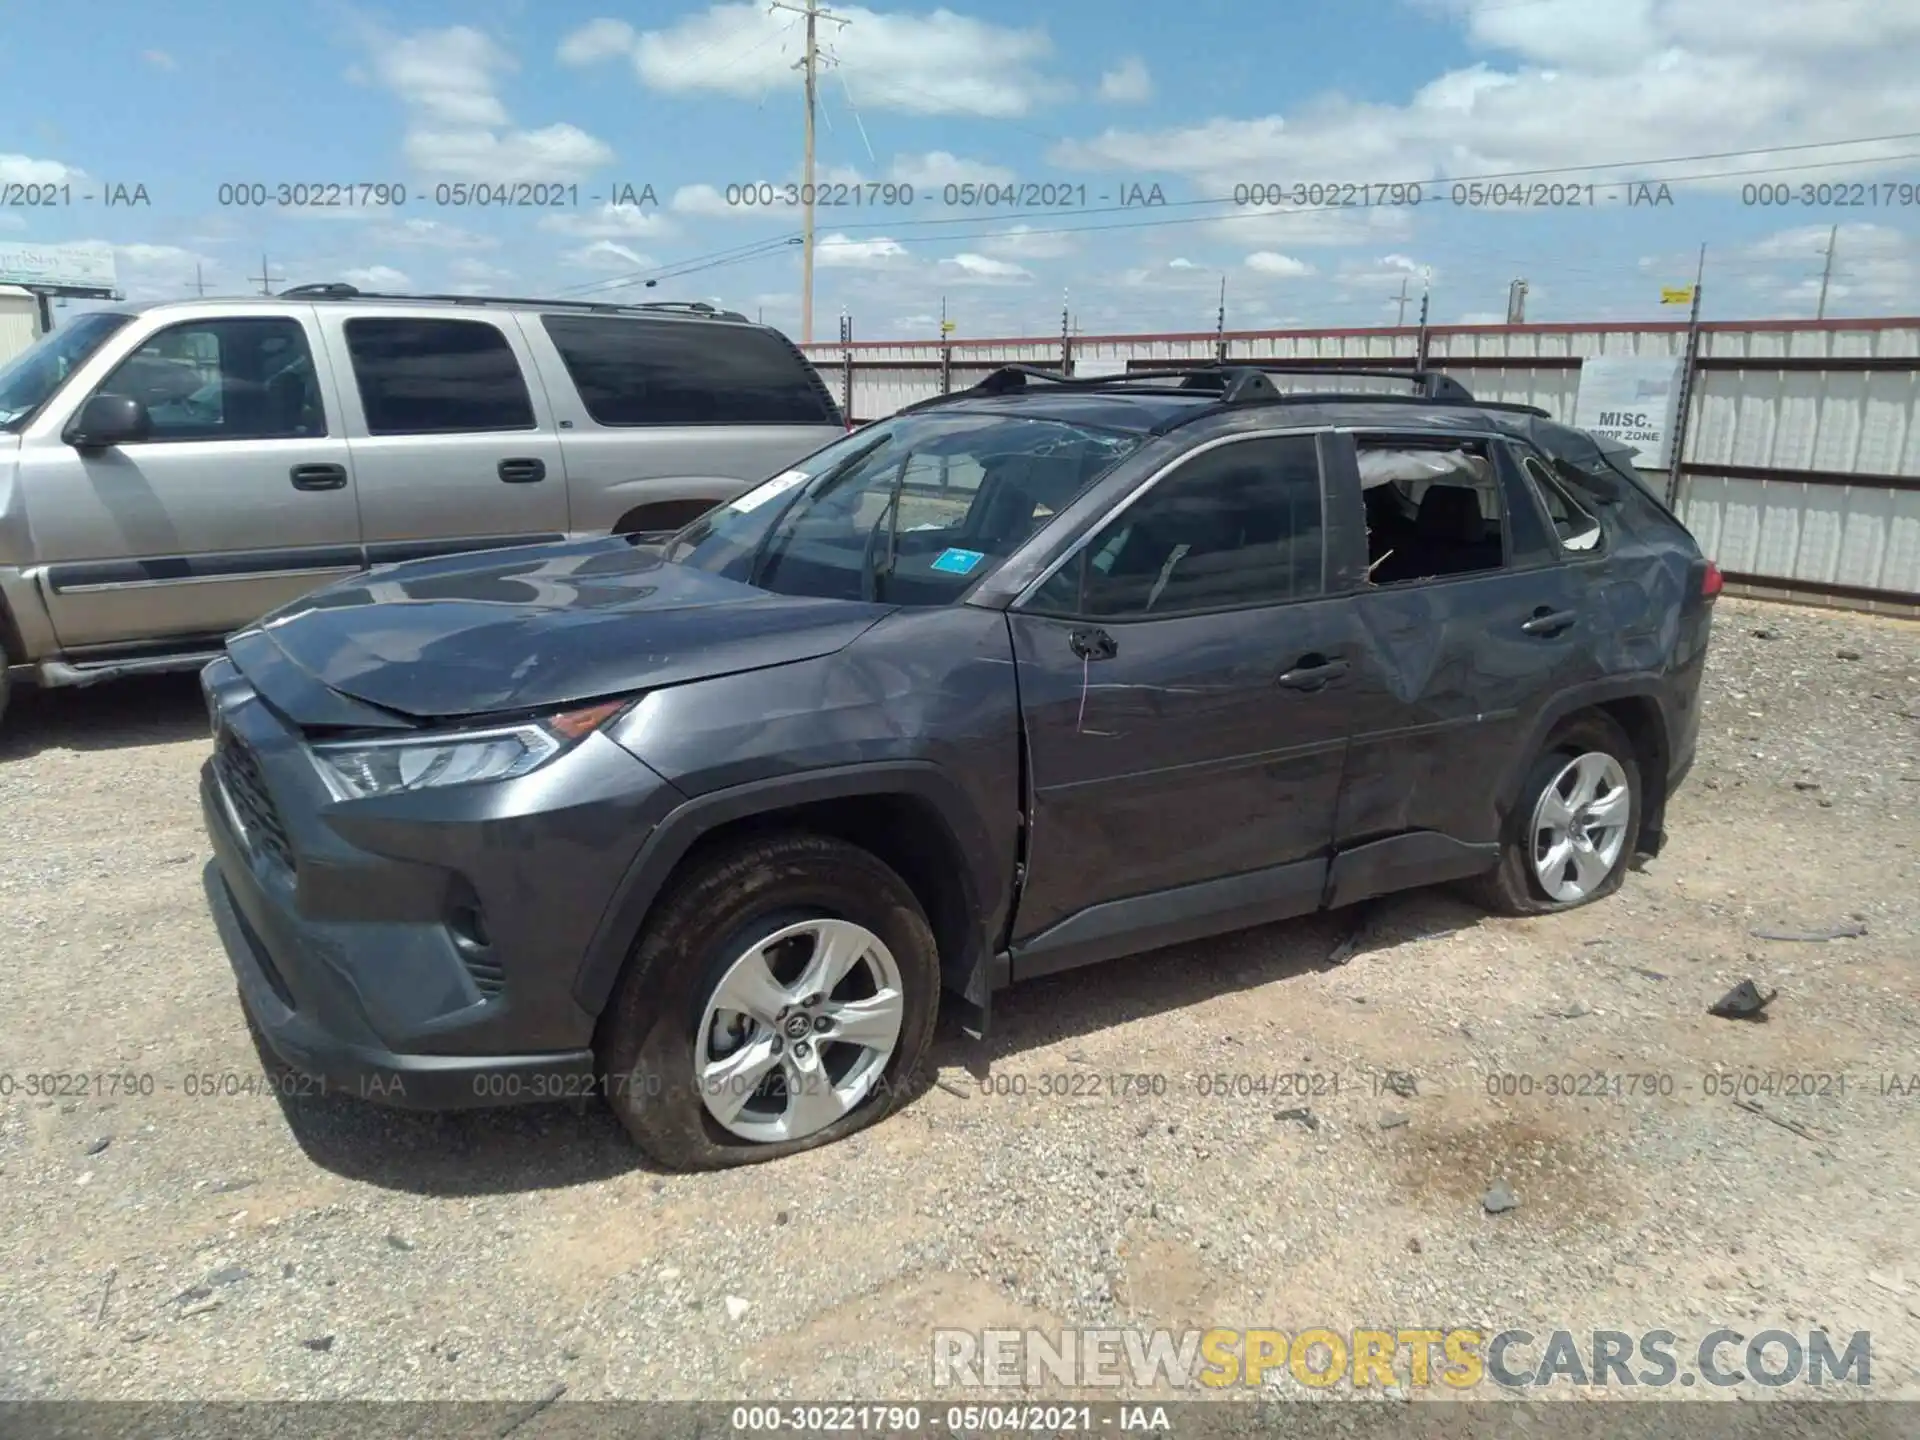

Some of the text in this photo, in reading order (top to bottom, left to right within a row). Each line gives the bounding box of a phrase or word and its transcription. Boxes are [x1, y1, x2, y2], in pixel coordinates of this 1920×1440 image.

[1599, 411, 1652, 428] MISC.
[1591, 430, 1660, 442] ROP ZONE
